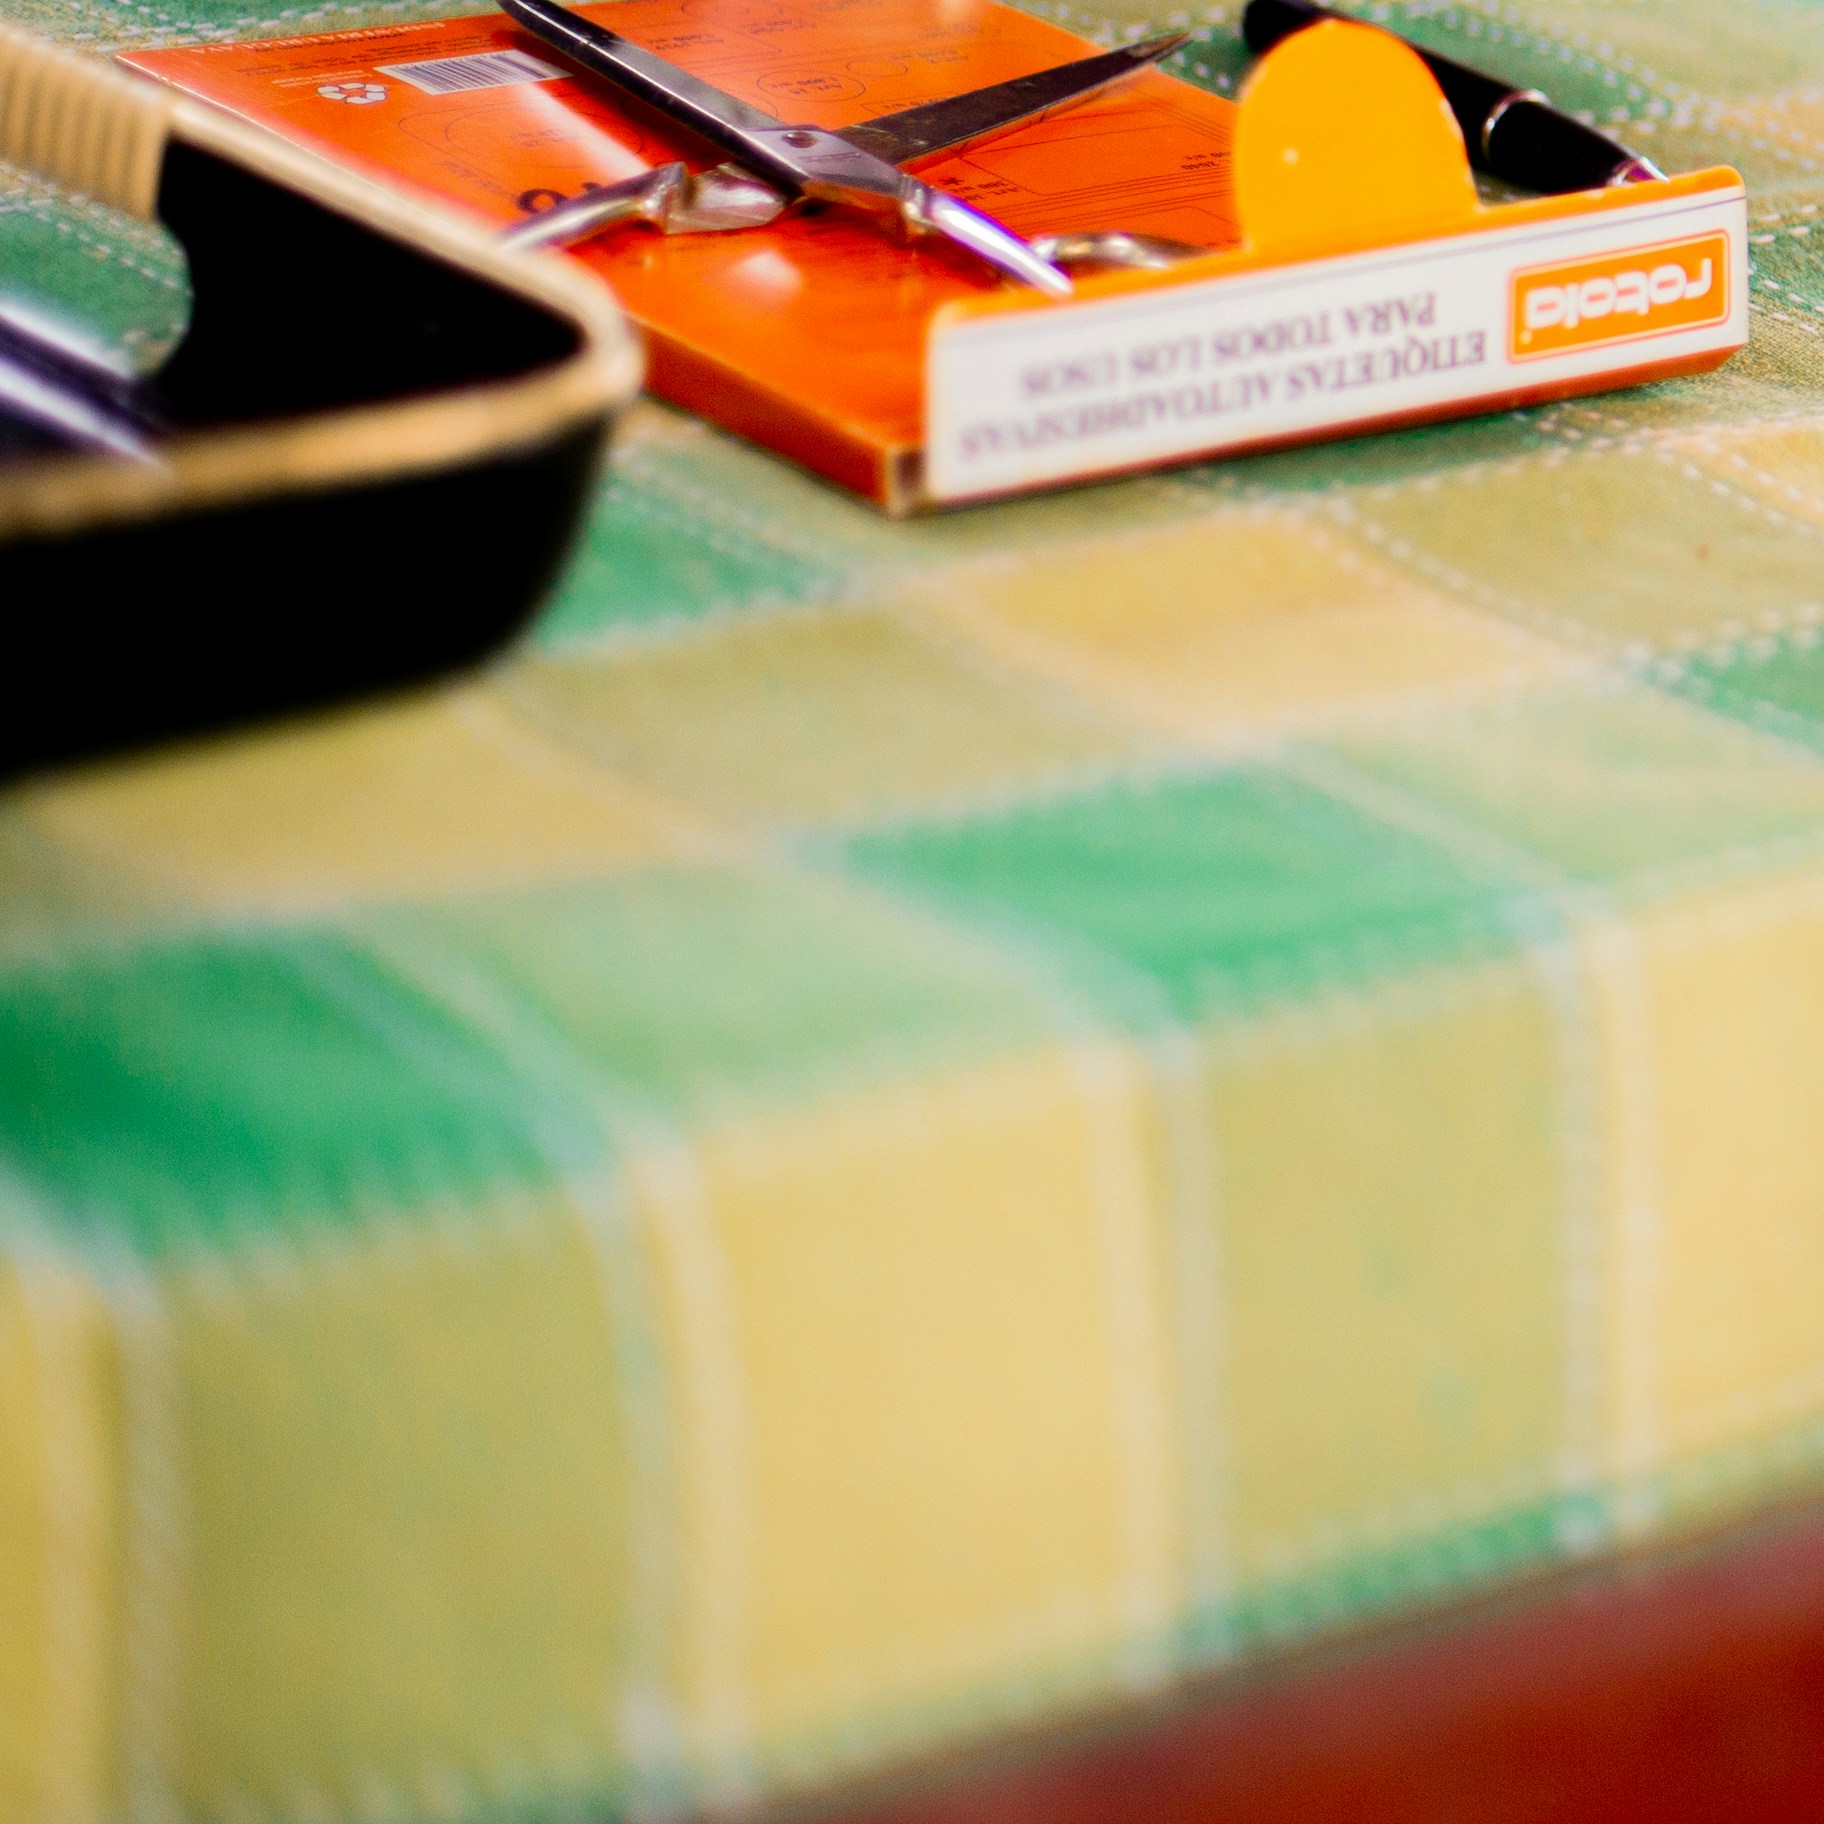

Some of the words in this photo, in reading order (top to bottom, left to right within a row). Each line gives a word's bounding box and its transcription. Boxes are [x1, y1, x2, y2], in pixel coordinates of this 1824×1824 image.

[1343, 292, 1437, 349] PARA
[1524, 258, 1713, 331] rotola
[1129, 330, 1204, 384] LOS
[1211, 307, 1340, 367] TODOS
[1288, 329, 1487, 403] ETIQUETAS
[959, 373, 1273, 463] AUTOADHESIVAS
